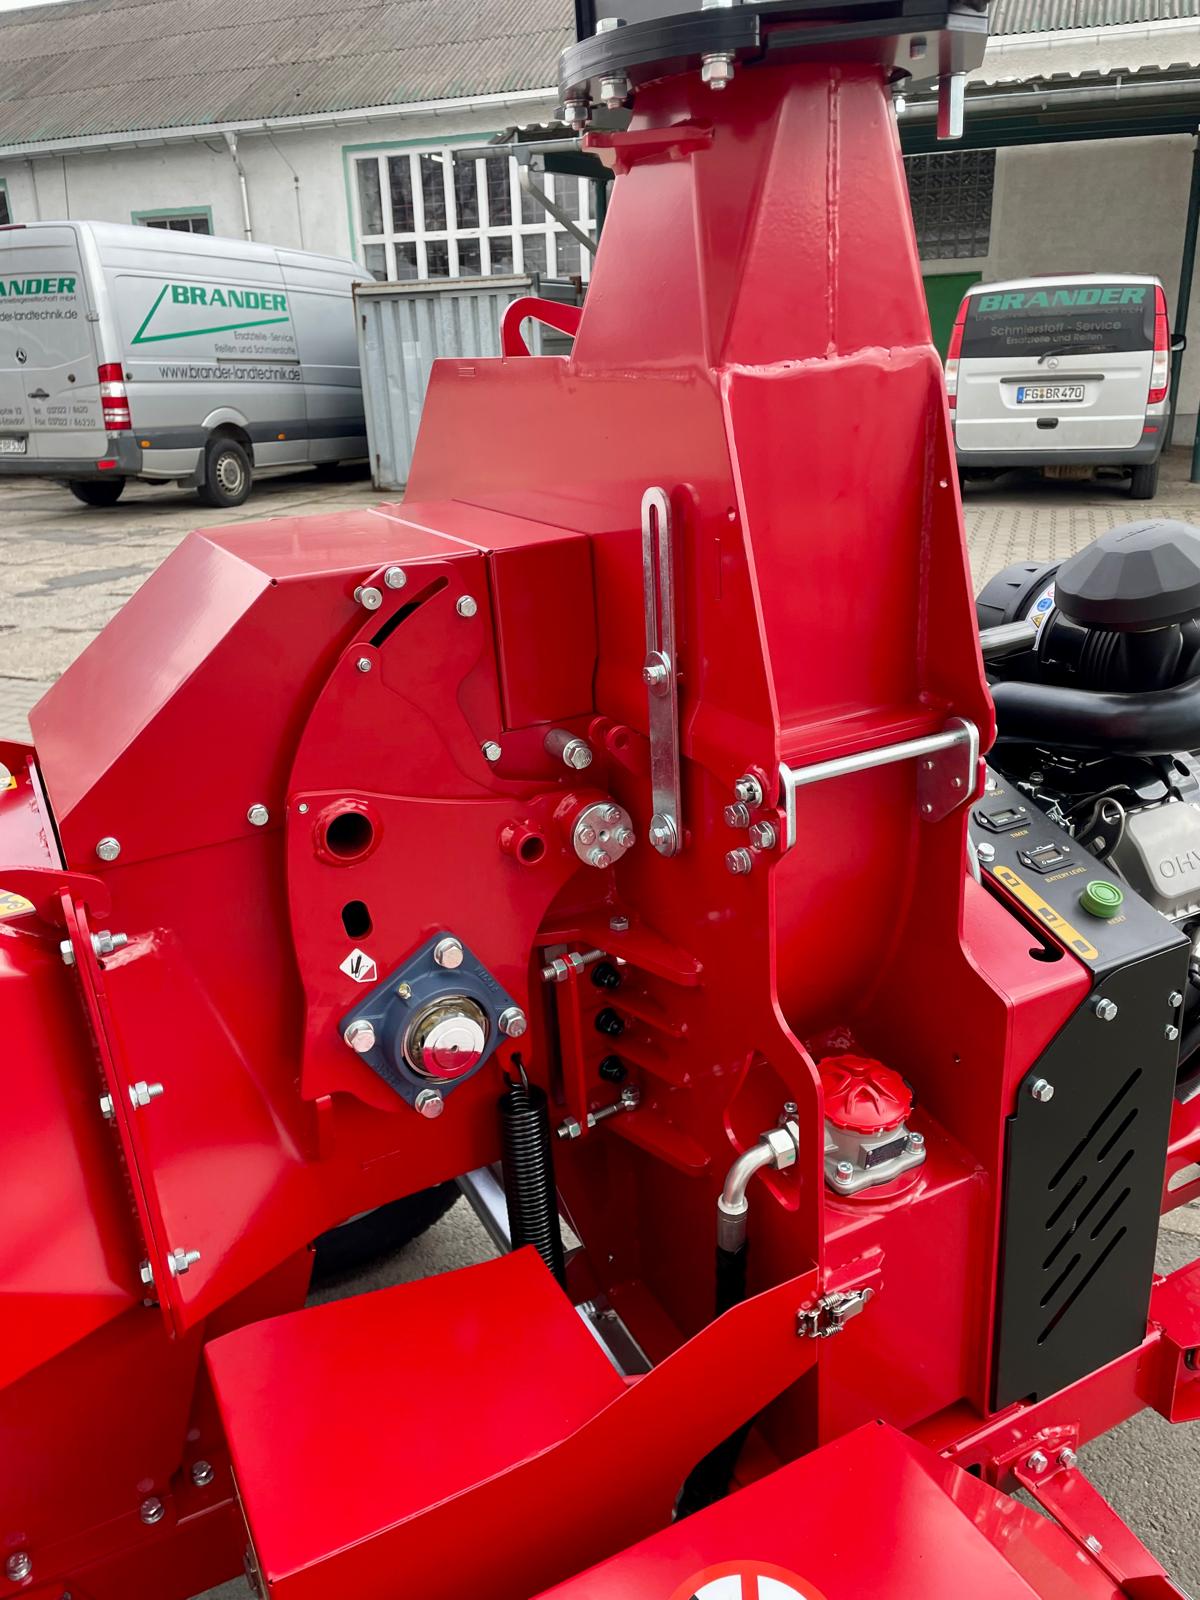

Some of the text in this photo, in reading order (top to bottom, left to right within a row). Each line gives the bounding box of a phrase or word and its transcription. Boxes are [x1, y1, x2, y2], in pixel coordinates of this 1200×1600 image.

[171, 285, 287, 311] BRANDER
[978, 287, 1146, 312] BRANDER
[991, 322, 1064, 337] Schmierstoff
[1076, 320, 1122, 331] Service
[1006, 332, 1103, 345] Ersatzteile und Reifen
[159, 365, 300, 380] www.brander-landtechnik.de
[1025, 389, 1039, 399] FG
[1044, 866, 1088, 883] BATTERY LEVEL
